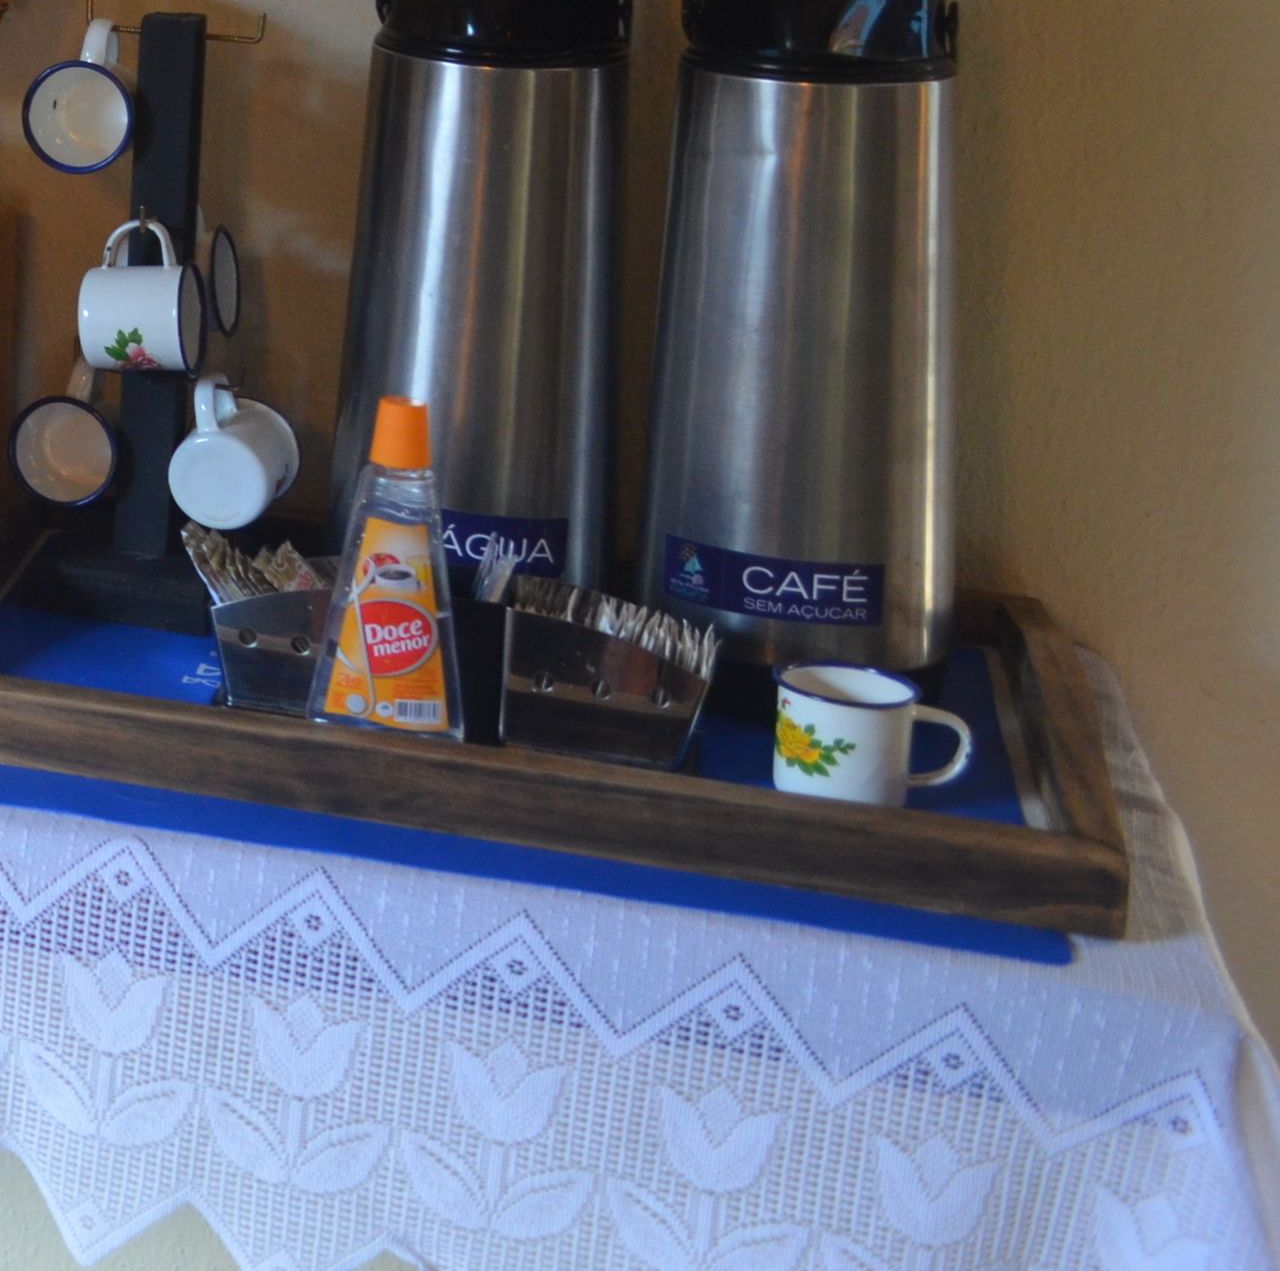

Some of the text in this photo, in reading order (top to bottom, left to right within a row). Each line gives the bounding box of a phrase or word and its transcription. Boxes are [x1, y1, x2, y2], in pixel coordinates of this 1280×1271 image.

[442, 524, 555, 564] ÁGUA
[742, 565, 869, 604] CAFÉ
[743, 596, 783, 615] SEM
[364, 618, 424, 645] Doce
[373, 634, 430, 658] menor
